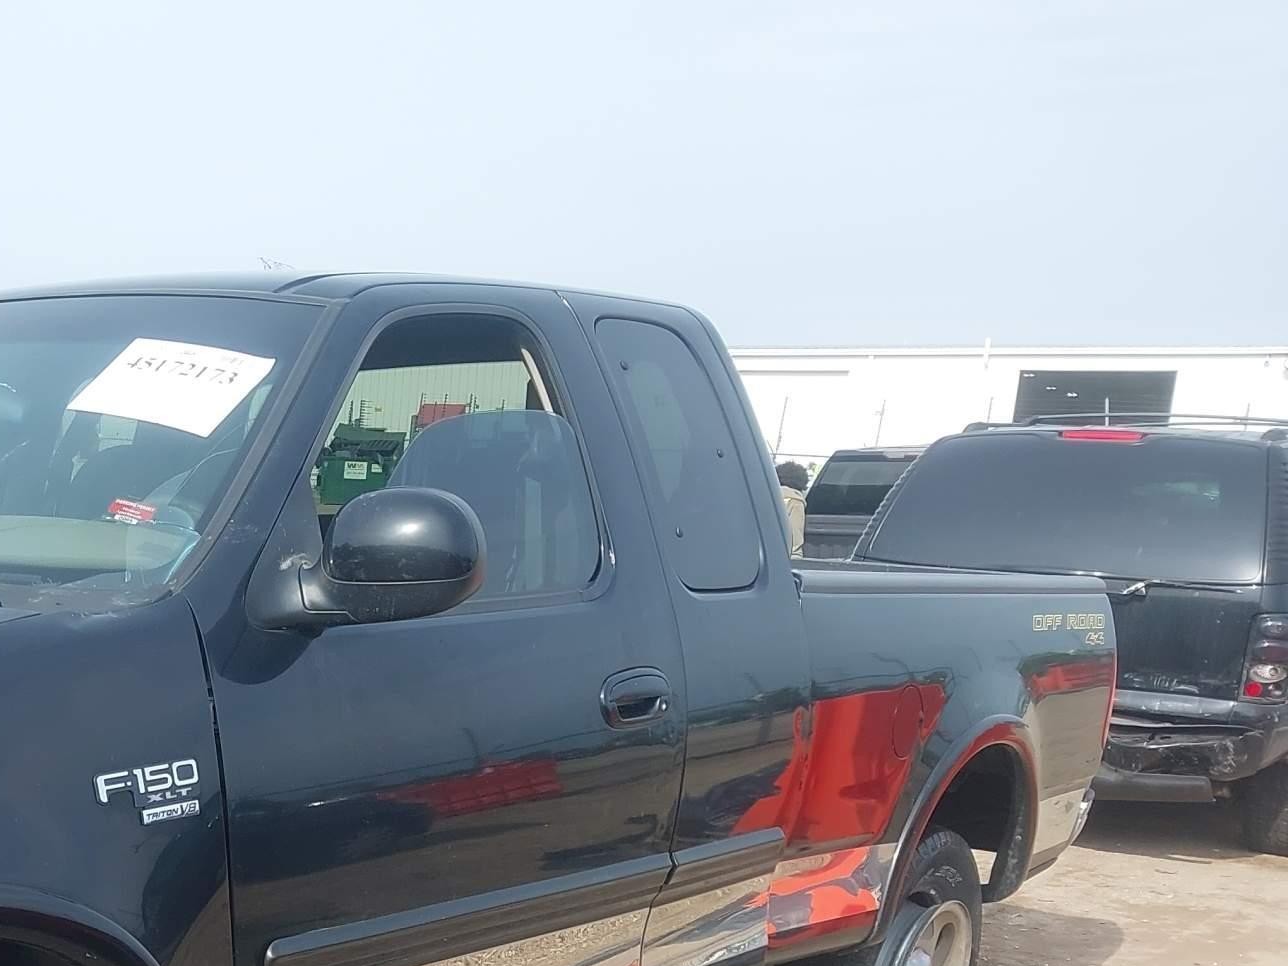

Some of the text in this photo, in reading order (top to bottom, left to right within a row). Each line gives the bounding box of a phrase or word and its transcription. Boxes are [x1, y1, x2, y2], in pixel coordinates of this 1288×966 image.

[1032, 613, 1105, 631] OFF ROAD
[147, 787, 192, 803] XLT
[145, 802, 198, 822] TRITON V8
